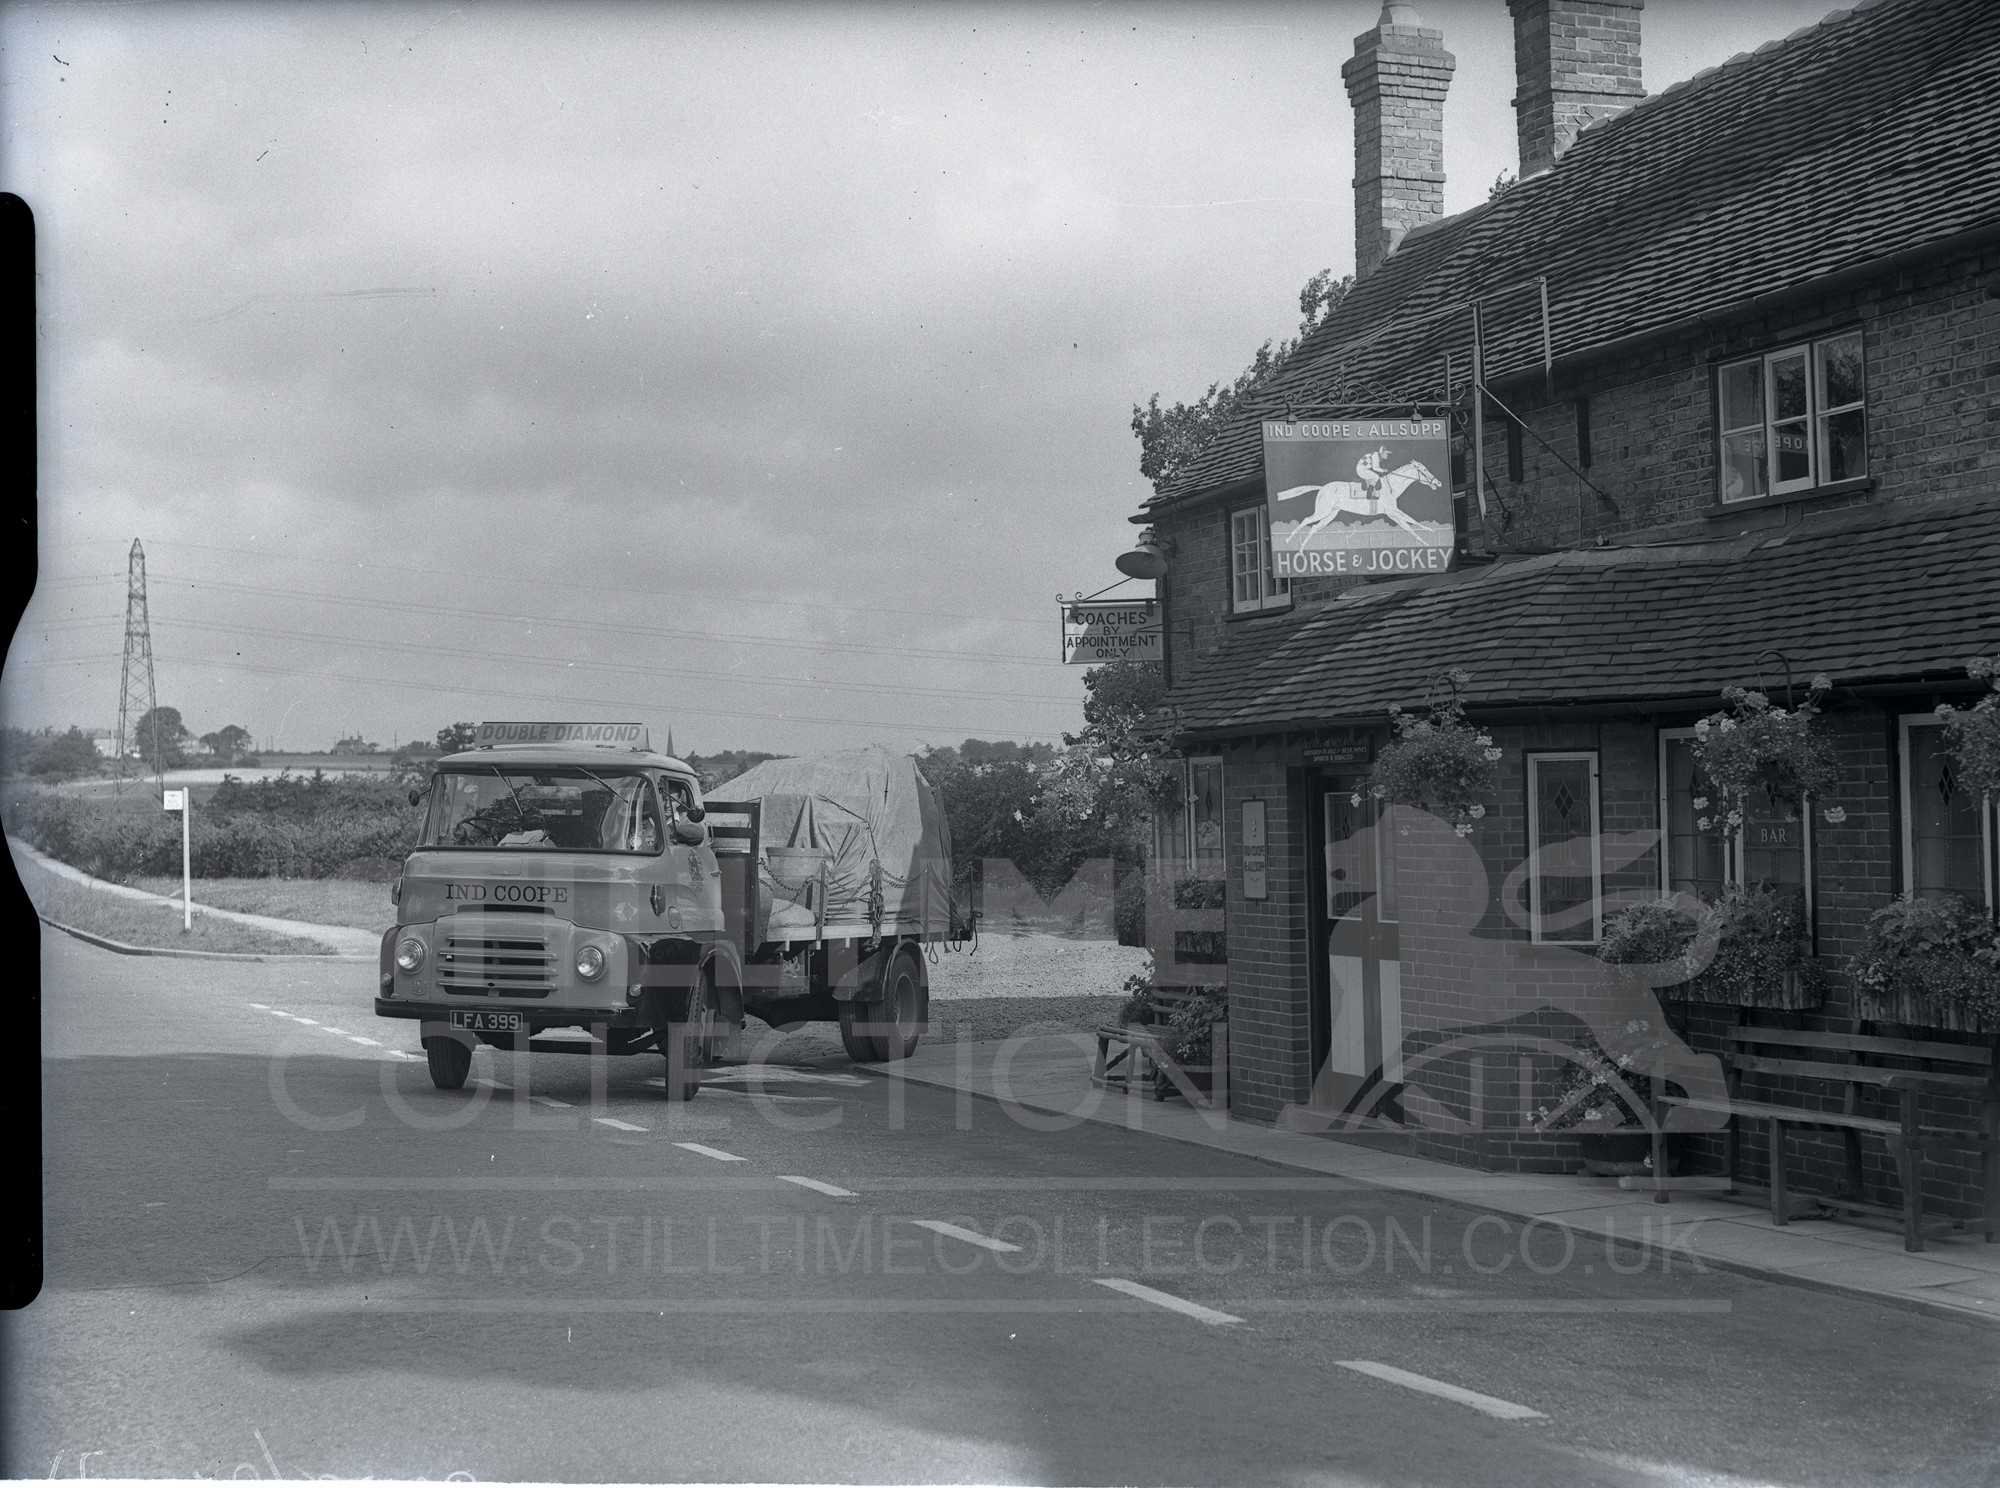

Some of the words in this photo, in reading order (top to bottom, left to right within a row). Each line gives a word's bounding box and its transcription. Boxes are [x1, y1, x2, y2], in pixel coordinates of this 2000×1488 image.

[1269, 423, 1293, 437] IND
[1302, 423, 1351, 437] COOPE
[1368, 422, 1442, 437] ALLSOPP
[1277, 551, 1347, 574] HORSE
[1366, 547, 1453, 572] JOCKEY
[1075, 611, 1147, 625] COACHES
[1103, 625, 1120, 635] BY
[1066, 634, 1157, 648] APPOINTMENT
[1095, 647, 1130, 658] ONLY
[481, 724, 550, 741] DOUBLE
[554, 724, 641, 742] DIAMOND
[1761, 828, 1787, 843] BAR
[445, 883, 487, 901] IND
[494, 884, 568, 903] COOPE
[453, 1012, 484, 1029] LFA
[488, 1013, 519, 1031] 399
